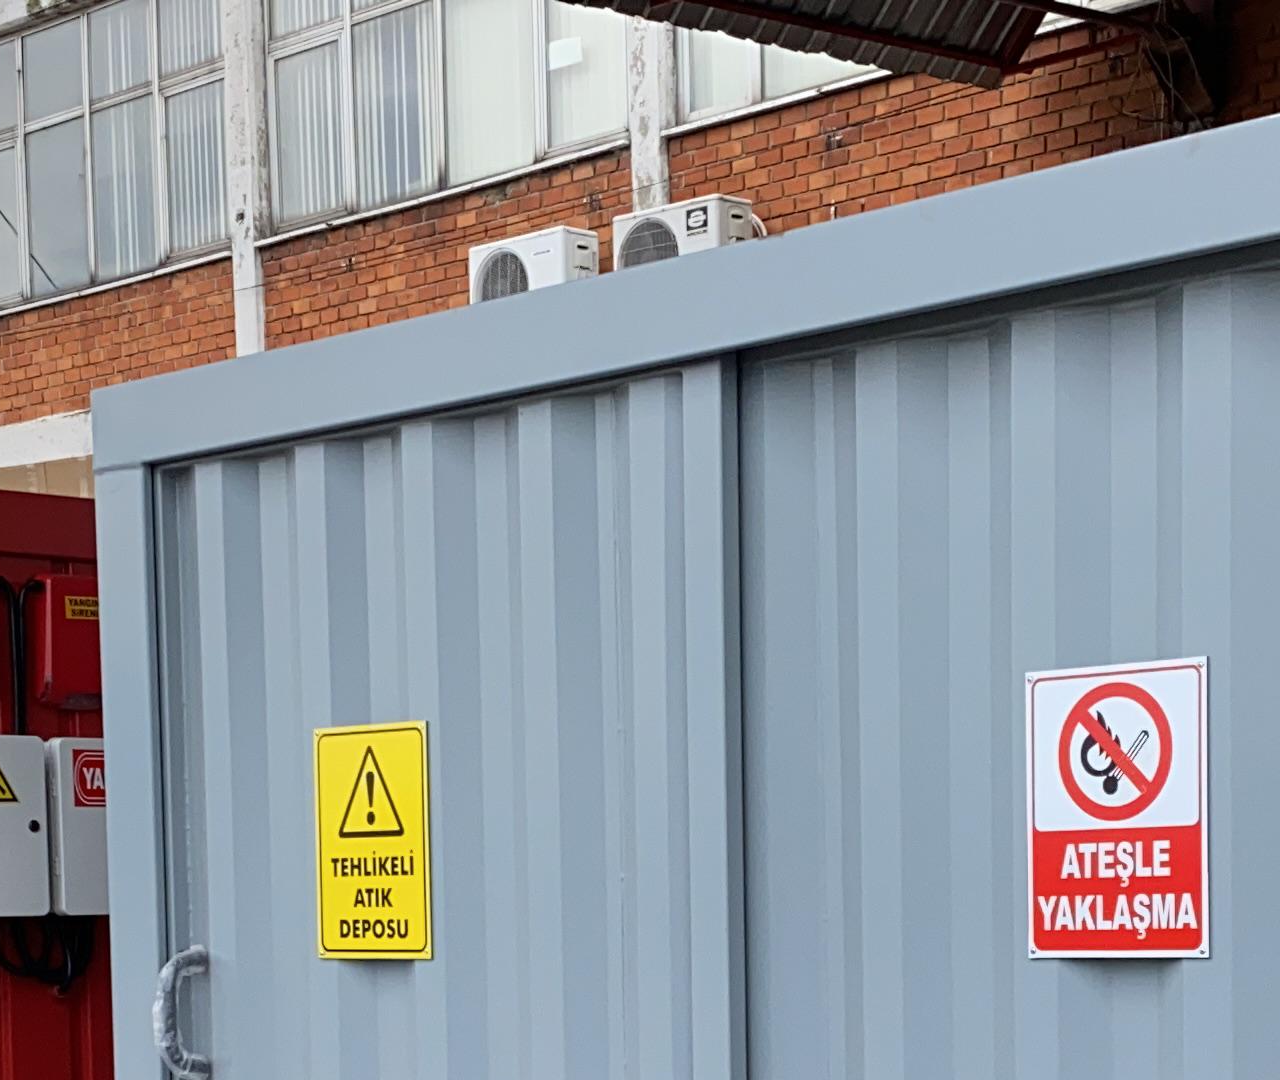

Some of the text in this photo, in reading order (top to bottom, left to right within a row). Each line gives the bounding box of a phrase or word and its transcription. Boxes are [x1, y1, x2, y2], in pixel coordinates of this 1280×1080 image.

[331, 850, 414, 878] TEHLİKELİ
[1060, 840, 1171, 888] ATEŞLE
[353, 888, 393, 908] ATIK
[339, 919, 409, 939] DEPOSU
[1037, 893, 1198, 940] YAKLAŞMA
